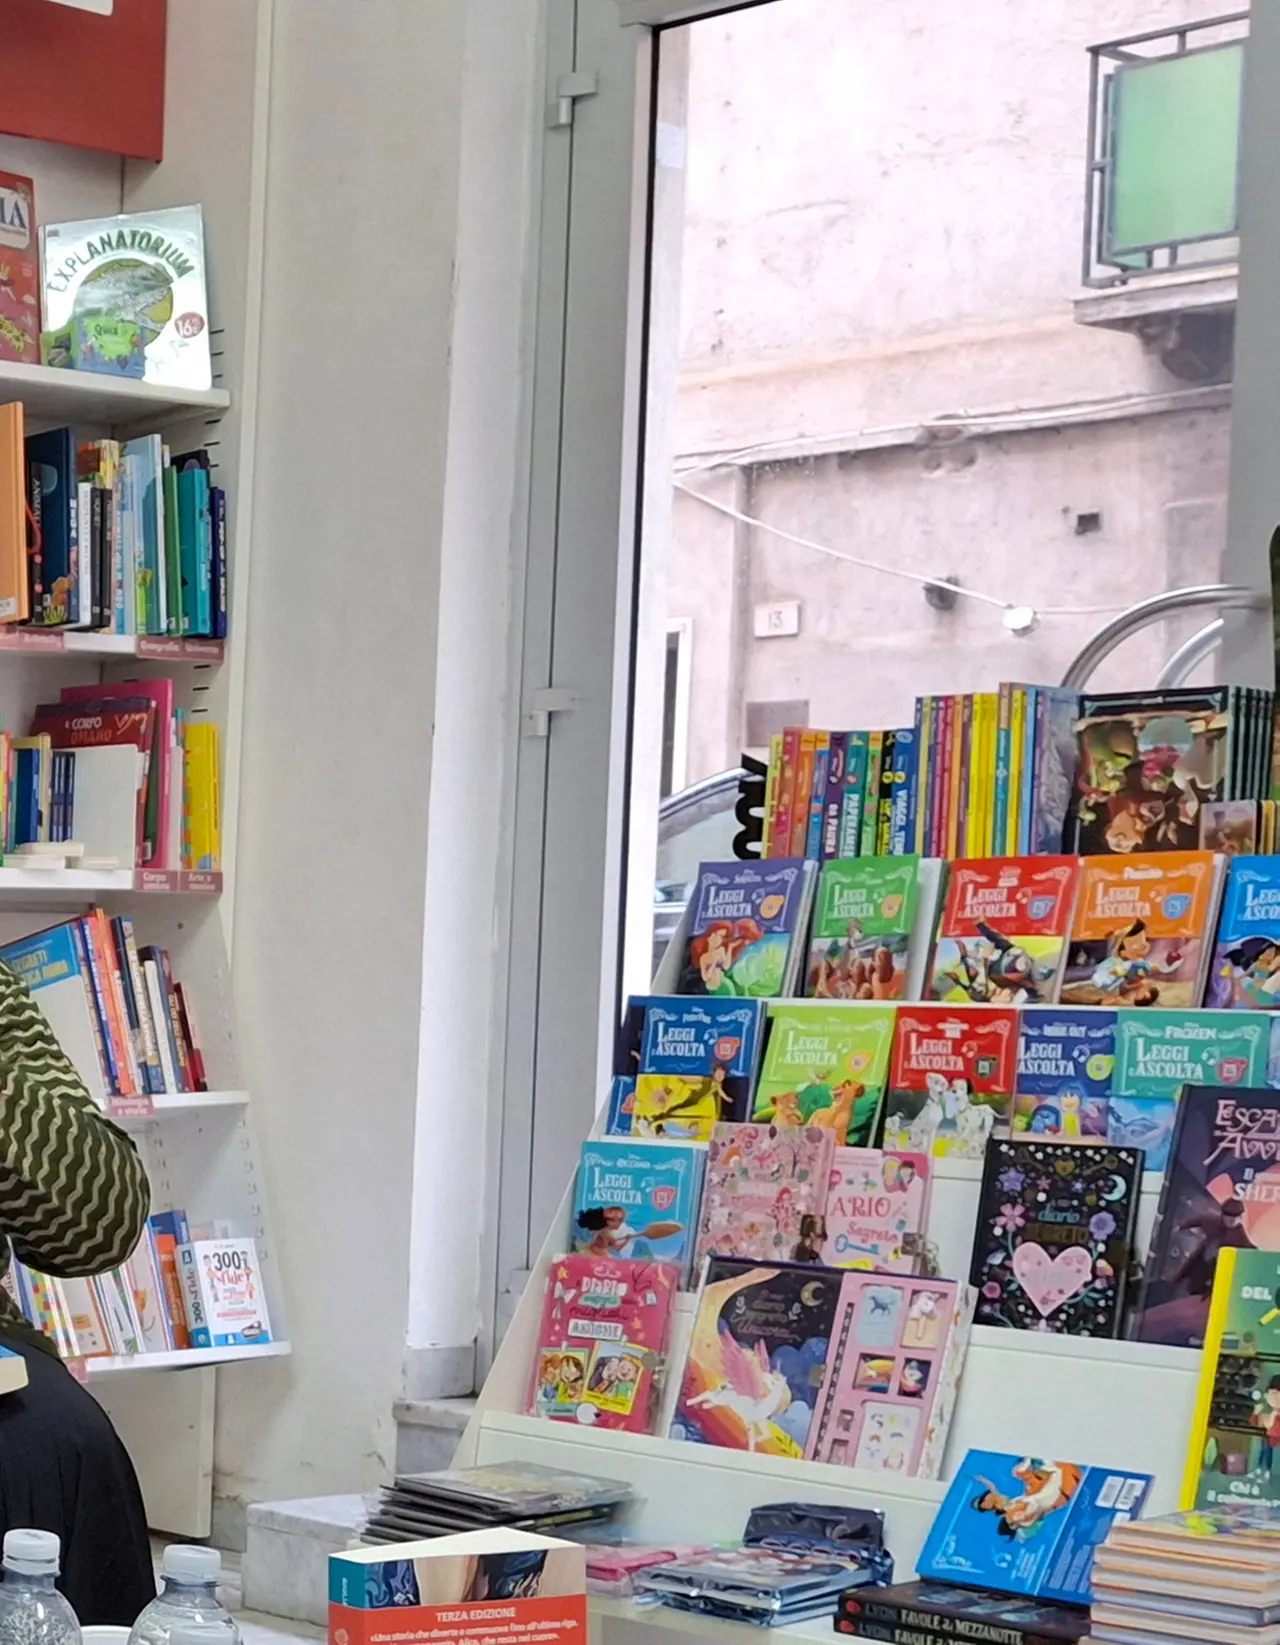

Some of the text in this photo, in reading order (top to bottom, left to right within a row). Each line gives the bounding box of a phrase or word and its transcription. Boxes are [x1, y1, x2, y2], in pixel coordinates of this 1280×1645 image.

[47, 228, 194, 293] EXPLANATORIUM
[71, 716, 103, 730] CORPO
[895, 790, 908, 826] VIAGGI
[825, 819, 838, 853] PAURA
[709, 885, 744, 904] LEGGI
[966, 882, 1008, 907] LEGGI
[706, 902, 752, 918] ASCOLTA
[964, 901, 1017, 918] ASCOLTA
[657, 1022, 695, 1042] LEGGI
[786, 1030, 828, 1051] LEGGI
[1164, 1026, 1218, 1040] FROZEN
[656, 1042, 706, 1058] ASCOLTA
[910, 1032, 953, 1057] LEGGI
[1018, 1036, 1063, 1060] LEGGI
[1135, 1036, 1190, 1061] LEGGI
[784, 1050, 838, 1066] ASCOLTA
[909, 1054, 964, 1072] ASCOLTA
[1017, 1060, 1076, 1077] ASCOLTA
[1134, 1061, 1204, 1079] ASCOLTA
[594, 1167, 633, 1188] LEGGI
[591, 1188, 642, 1205] ASCOLTA
[830, 1196, 890, 1218] ARIO
[212, 1250, 241, 1272] 300
[1241, 1285, 1272, 1300] DEL
[192, 1301, 203, 1323] 300
[435, 1607, 516, 1622] TERZA EDIZIONE
[392, 1630, 414, 1641] storia
[416, 1629, 429, 1640] che
[509, 1623, 526, 1634] fino
[900, 1608, 940, 1630] FAVOLE
[954, 1620, 1024, 1645] MEZZANOTTE
